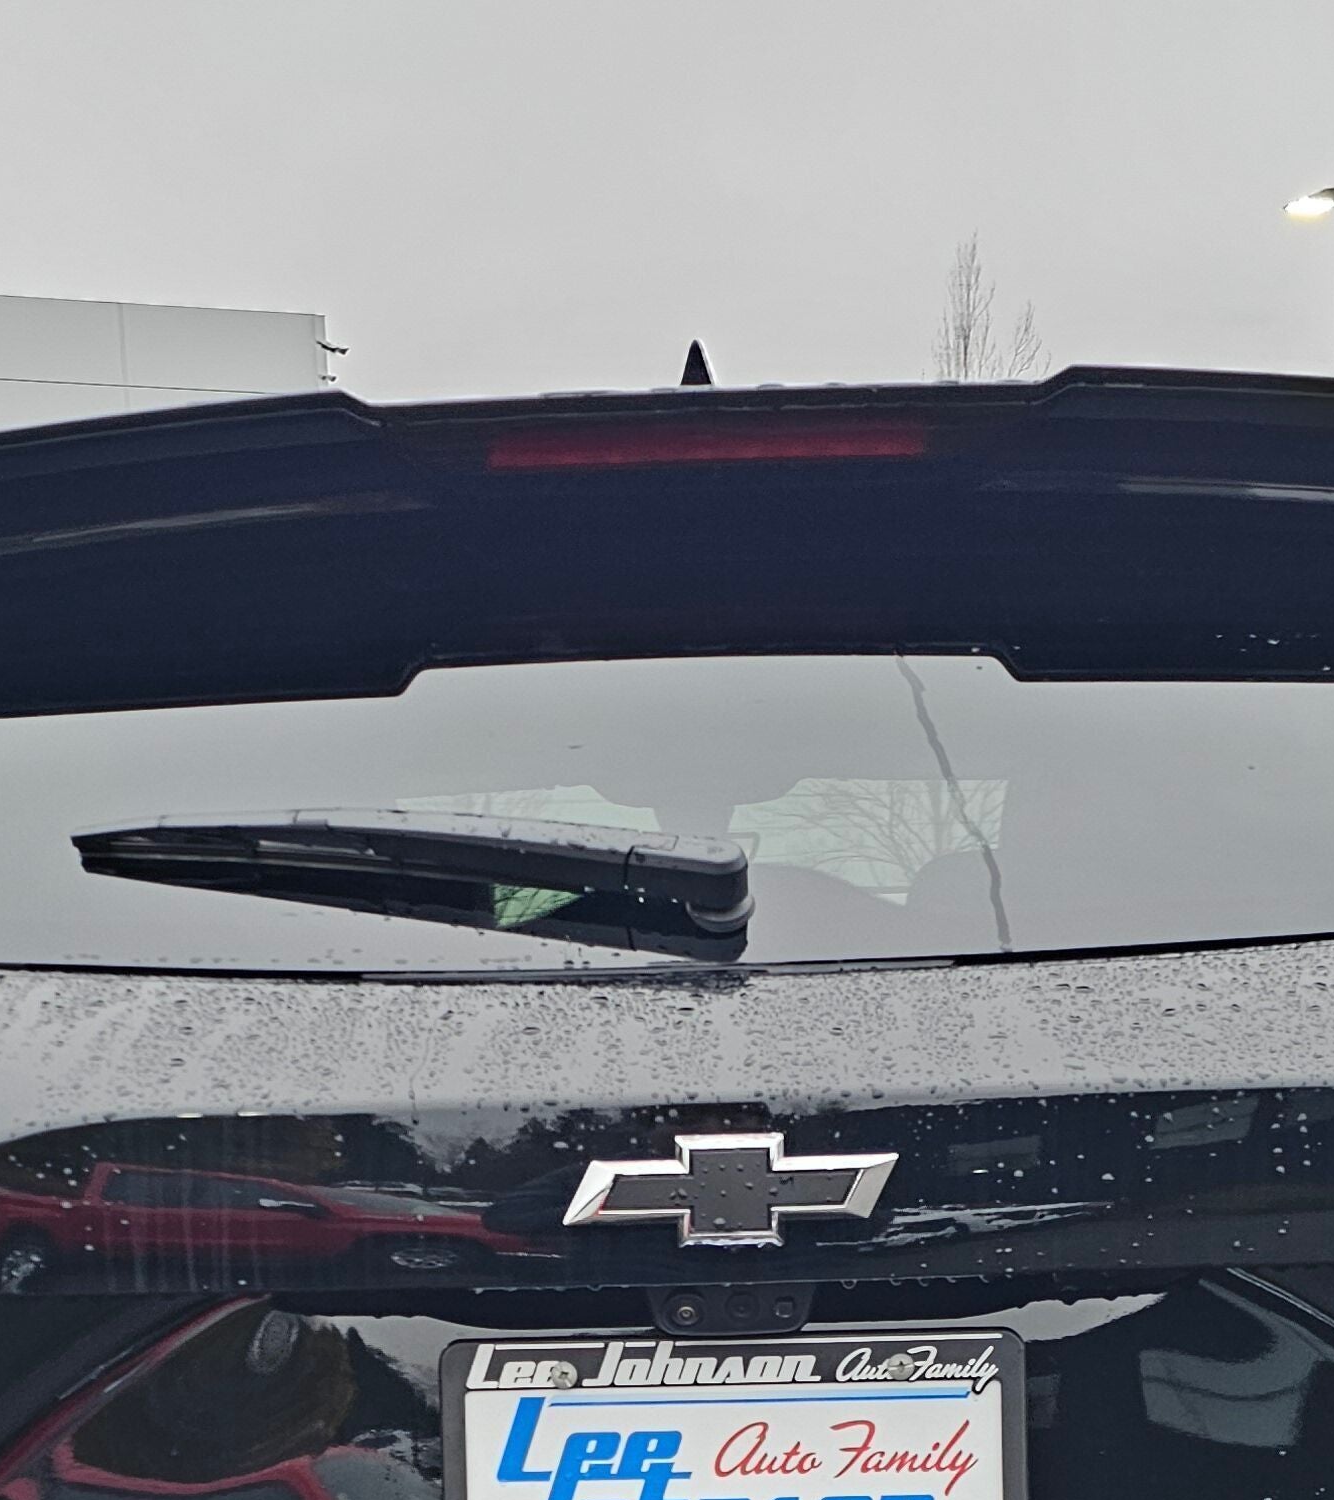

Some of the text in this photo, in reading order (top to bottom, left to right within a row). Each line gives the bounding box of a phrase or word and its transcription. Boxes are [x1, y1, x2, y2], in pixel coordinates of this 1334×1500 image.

[582, 1341, 821, 1387] Johnson
[836, 1347, 907, 1381] Aut
[906, 1345, 999, 1391] Family
[497, 1396, 691, 1482] Lee
[714, 1419, 979, 1496] Auto Family
